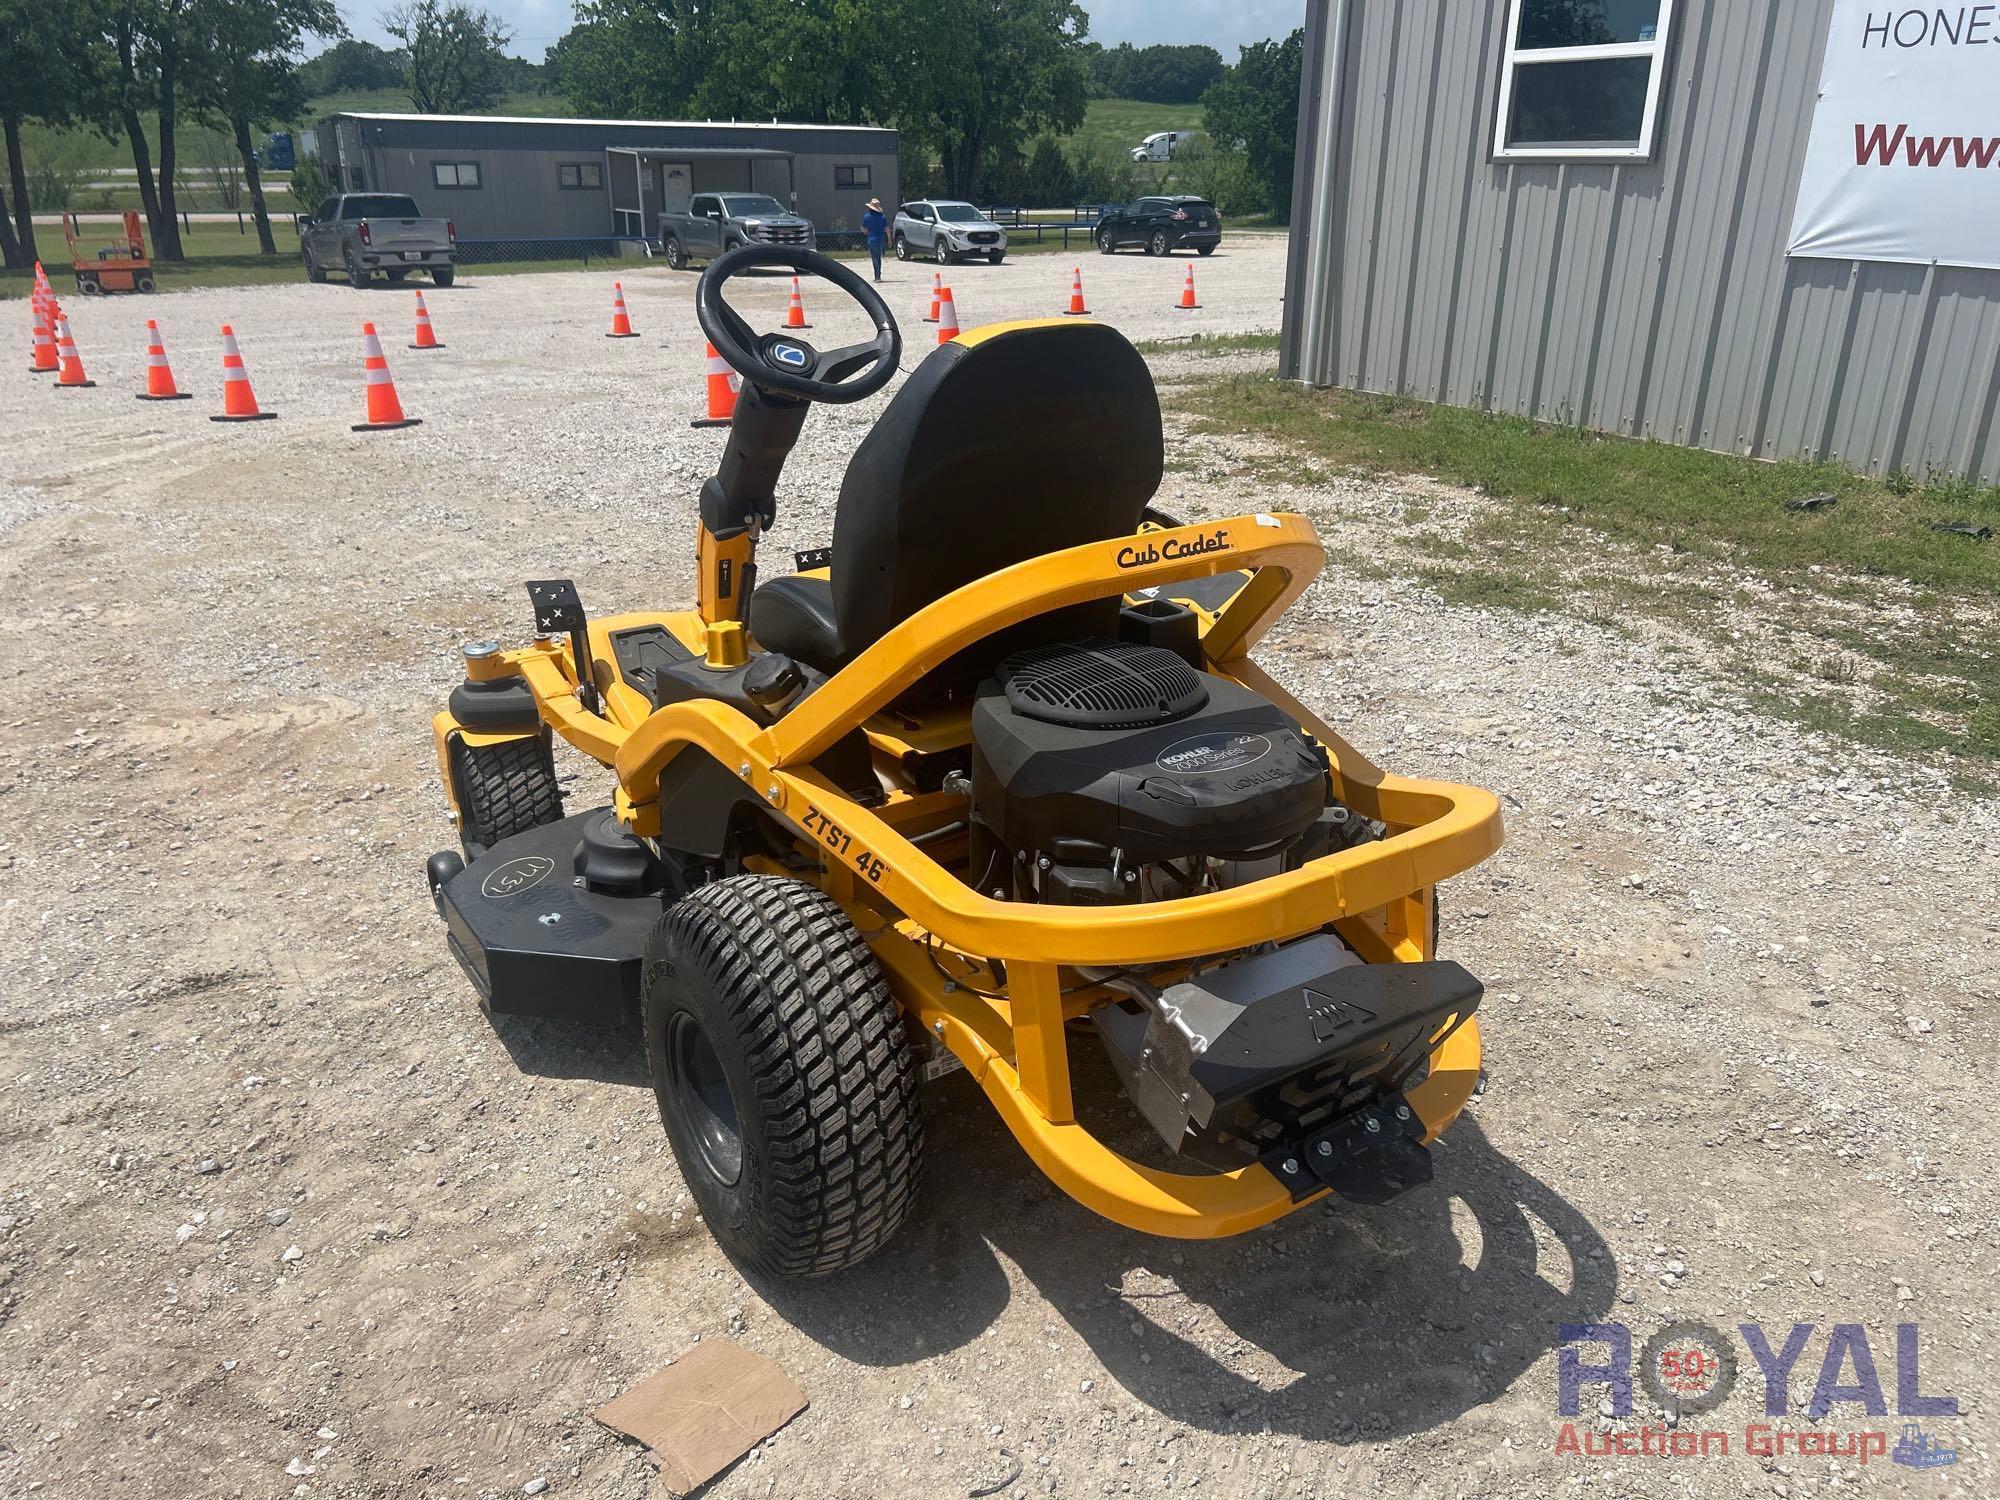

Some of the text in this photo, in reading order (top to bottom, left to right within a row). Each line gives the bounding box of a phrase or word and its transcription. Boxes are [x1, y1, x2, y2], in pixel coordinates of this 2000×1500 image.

[1862, 5, 2000, 48] HONE
[1116, 530, 1231, 569] Cub Cadet
[1234, 735, 1256, 745] 22
[1162, 746, 1215, 765] KOHLER
[1171, 756, 1207, 771] 7000
[1203, 747, 1246, 763] Series
[1223, 768, 1292, 792] KOHLER
[802, 804, 891, 883] ZTS1 46"
